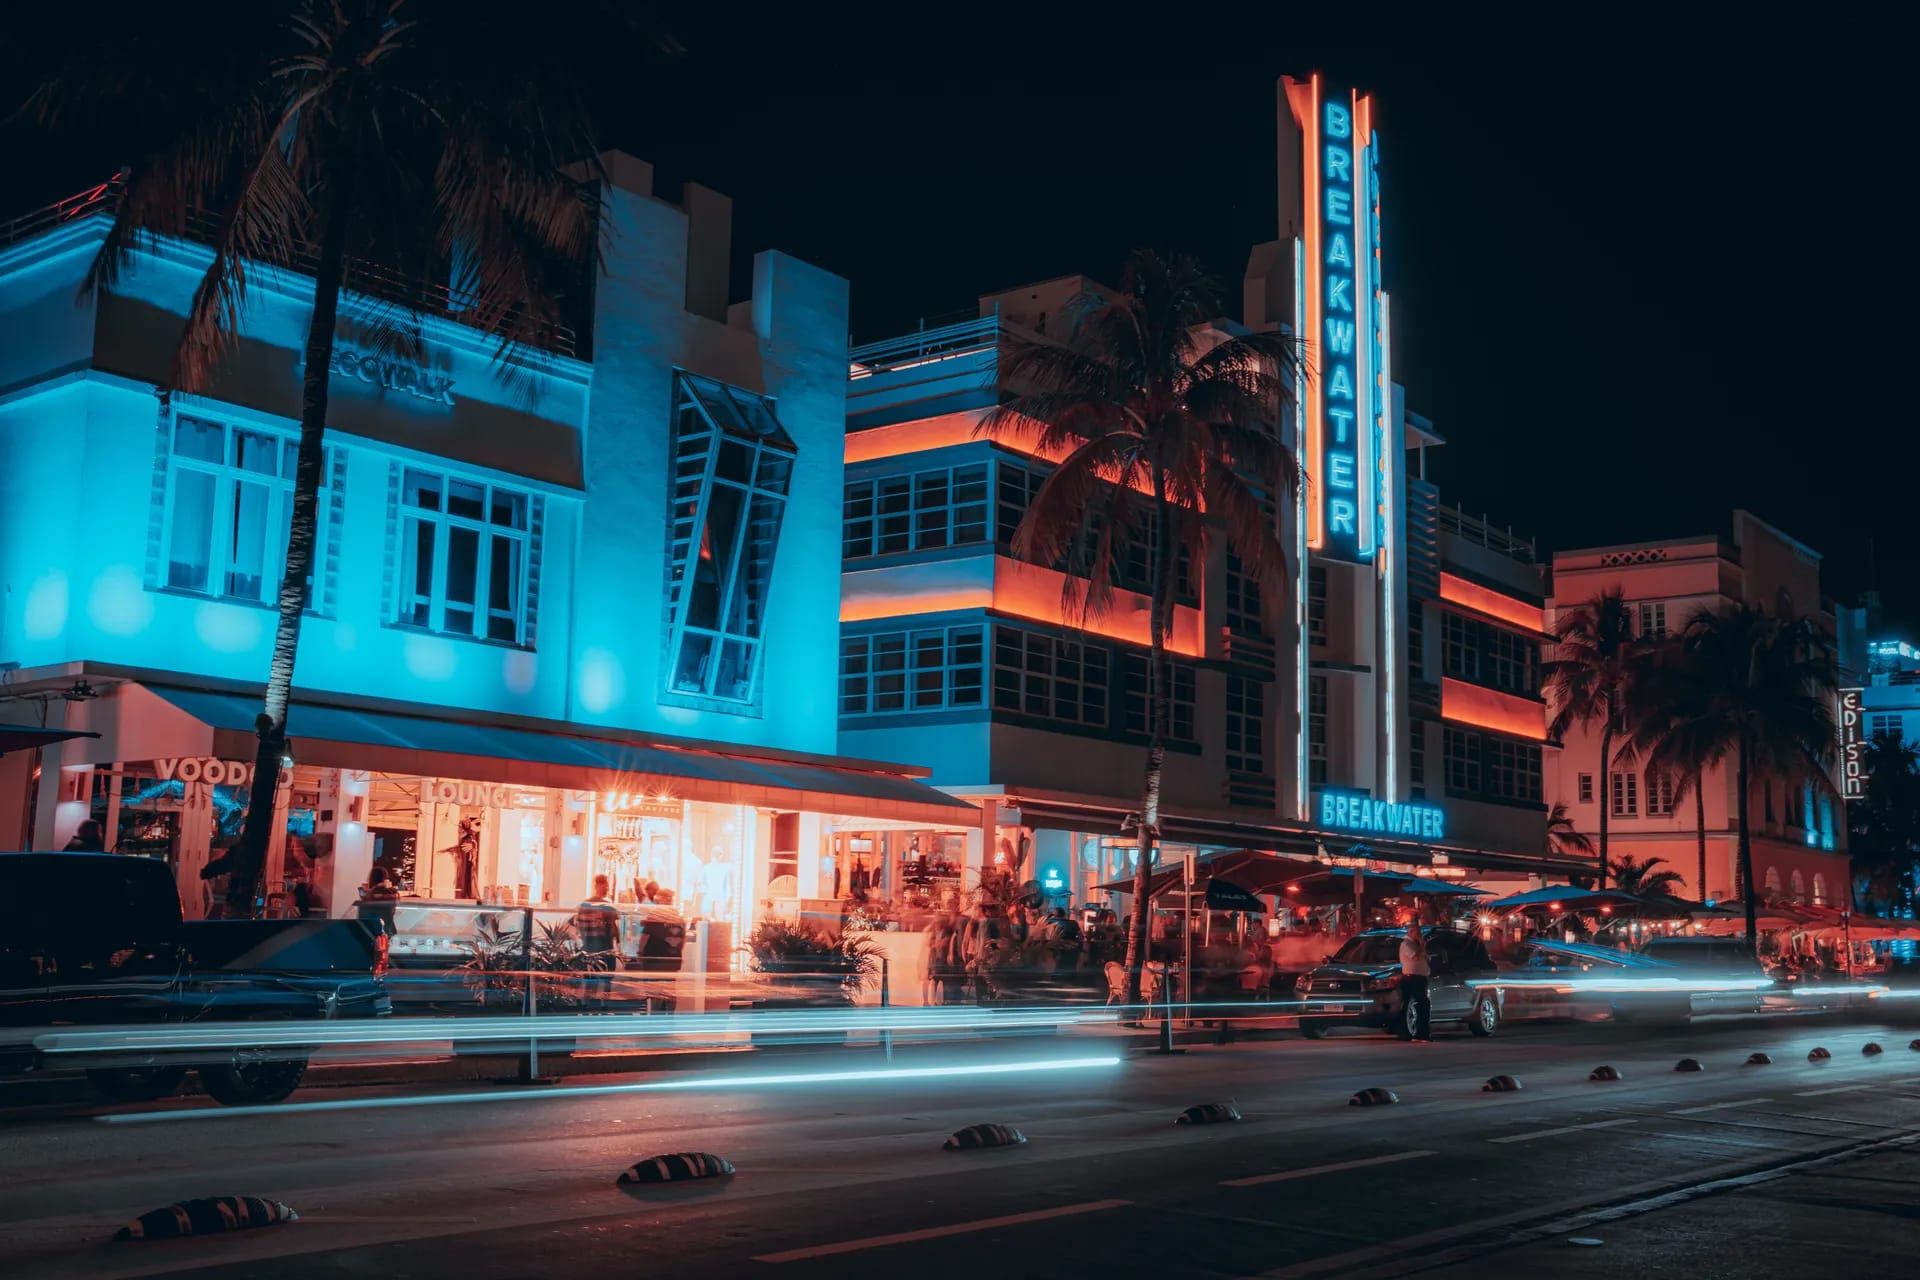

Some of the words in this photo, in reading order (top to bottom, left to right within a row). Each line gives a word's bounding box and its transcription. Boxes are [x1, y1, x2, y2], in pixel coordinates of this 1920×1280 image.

[1325, 102, 1356, 534] BREAKWATER
[1843, 692, 1860, 793] EDISON
[1322, 794, 1444, 838] BREAKWATER
